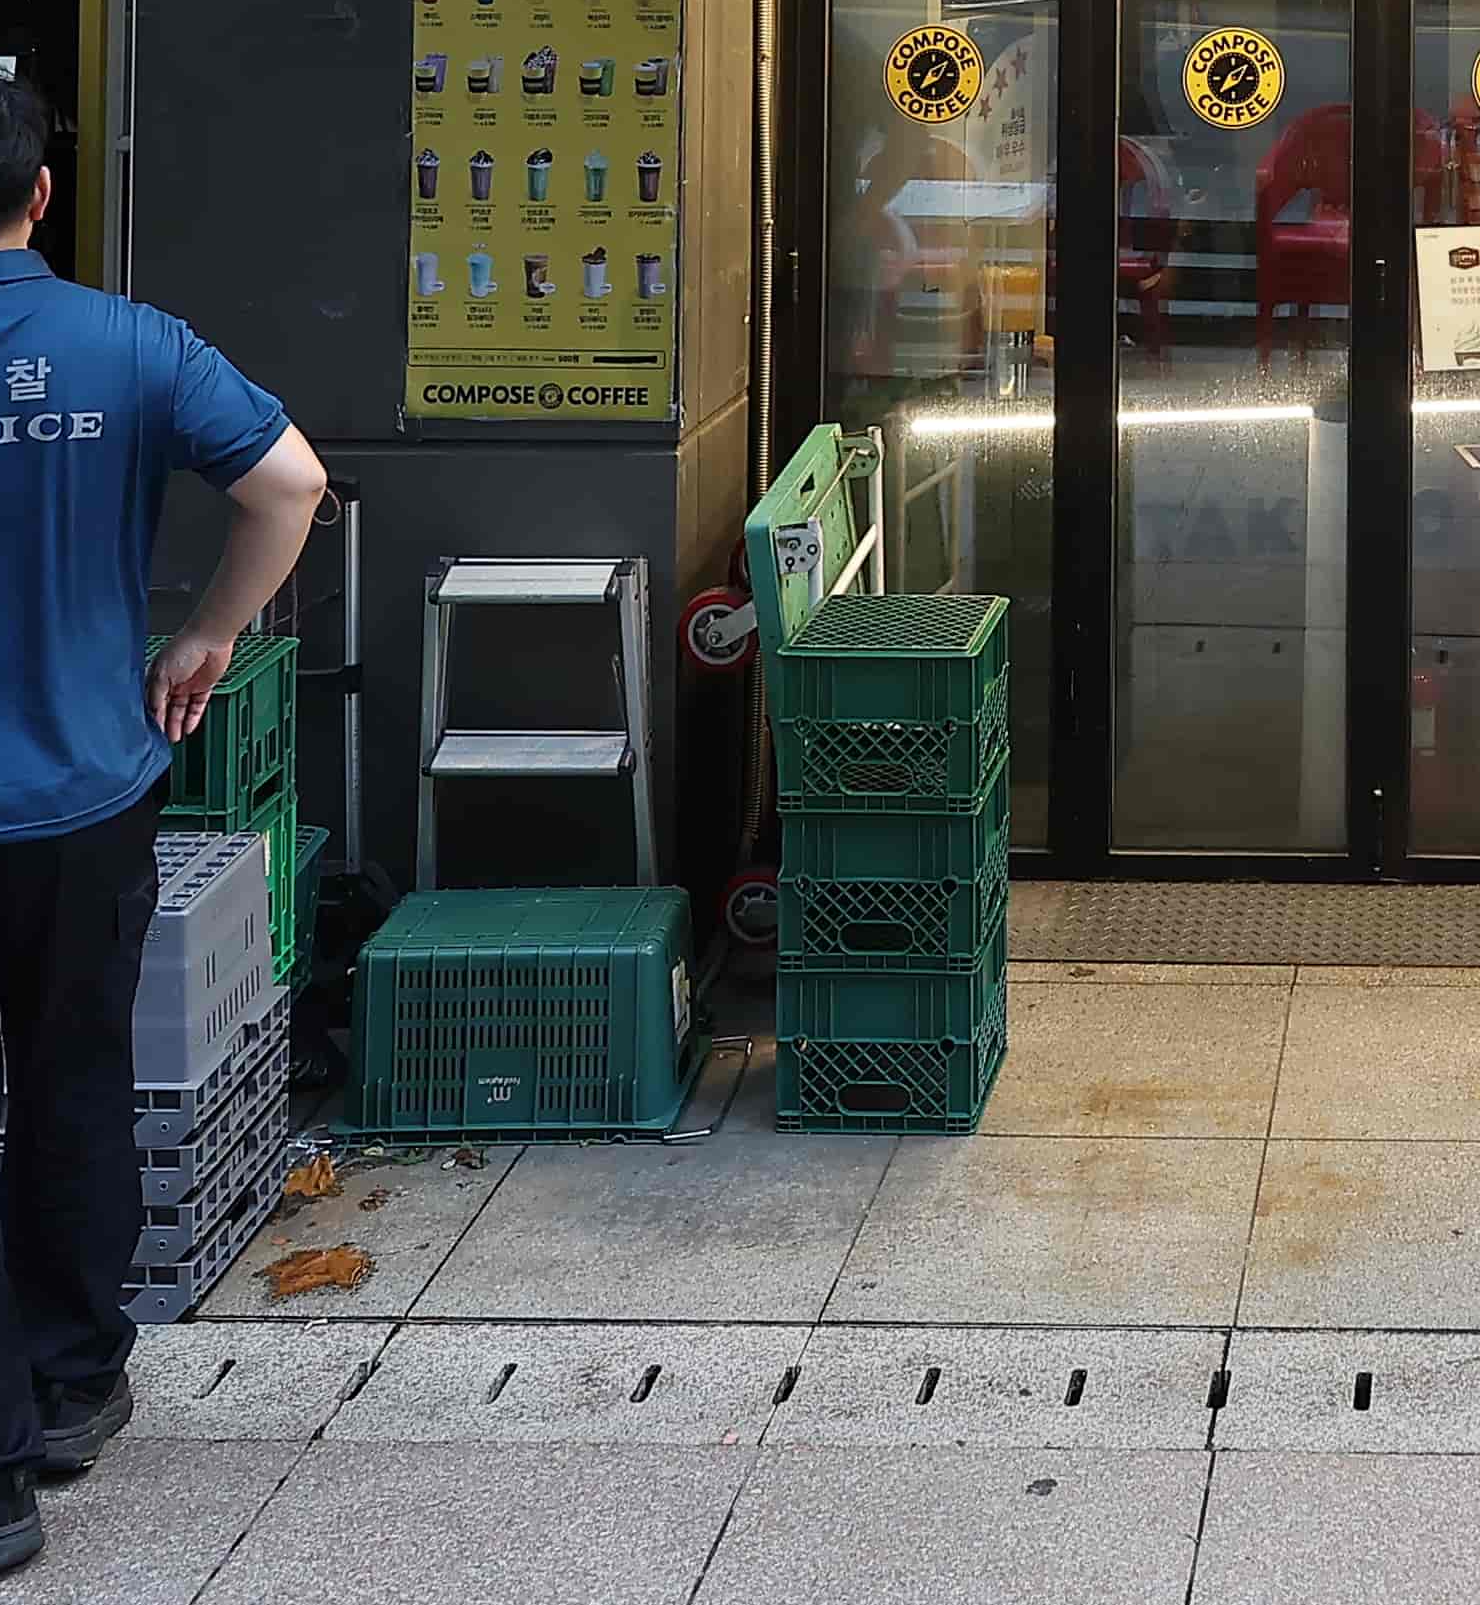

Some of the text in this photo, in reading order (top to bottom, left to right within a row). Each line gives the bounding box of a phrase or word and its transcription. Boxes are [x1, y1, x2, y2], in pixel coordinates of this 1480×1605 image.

[893, 32, 976, 70] COMPOSE
[1192, 35, 1276, 74] COMPOSE
[899, 90, 970, 118] COFFEE
[1198, 94, 1270, 121] COFFEE
[423, 384, 648, 406] COMPOSE COFFEE
